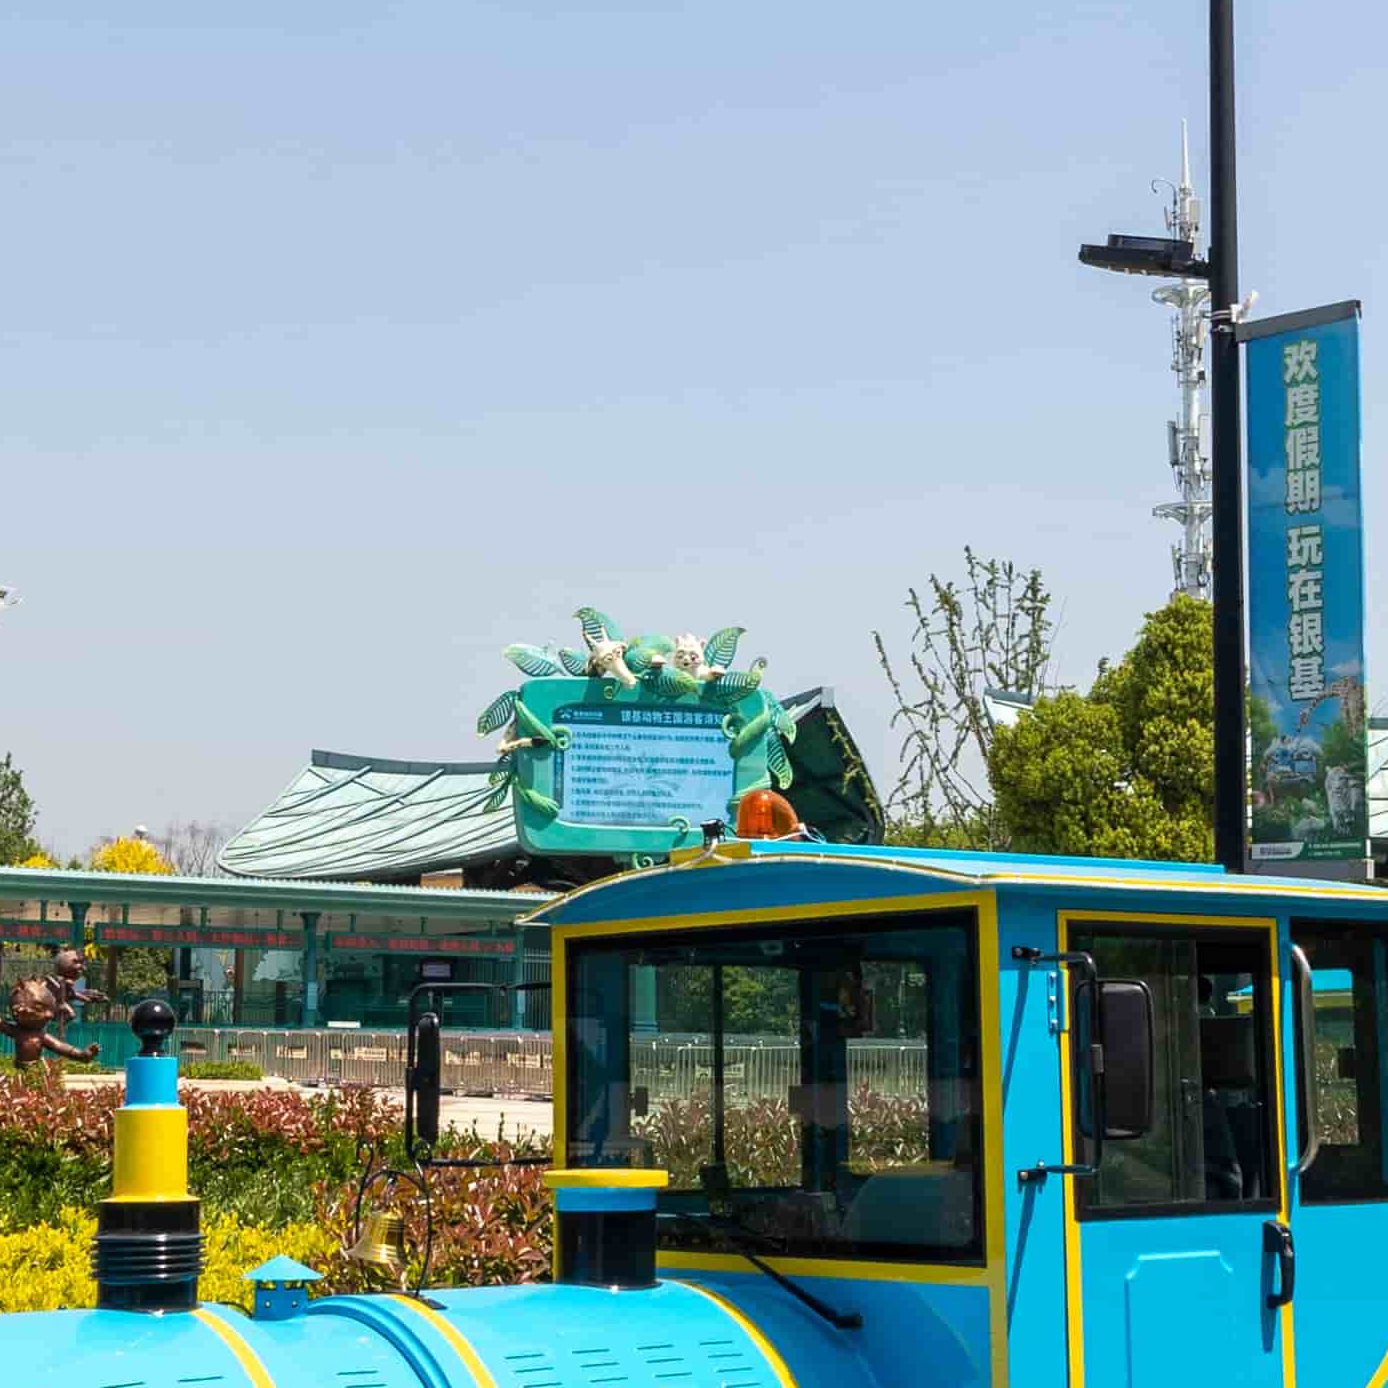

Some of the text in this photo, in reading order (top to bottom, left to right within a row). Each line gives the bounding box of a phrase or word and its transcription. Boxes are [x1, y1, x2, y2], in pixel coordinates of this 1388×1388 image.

[1284, 340, 1325, 700] 欢度假期 玩在银基
